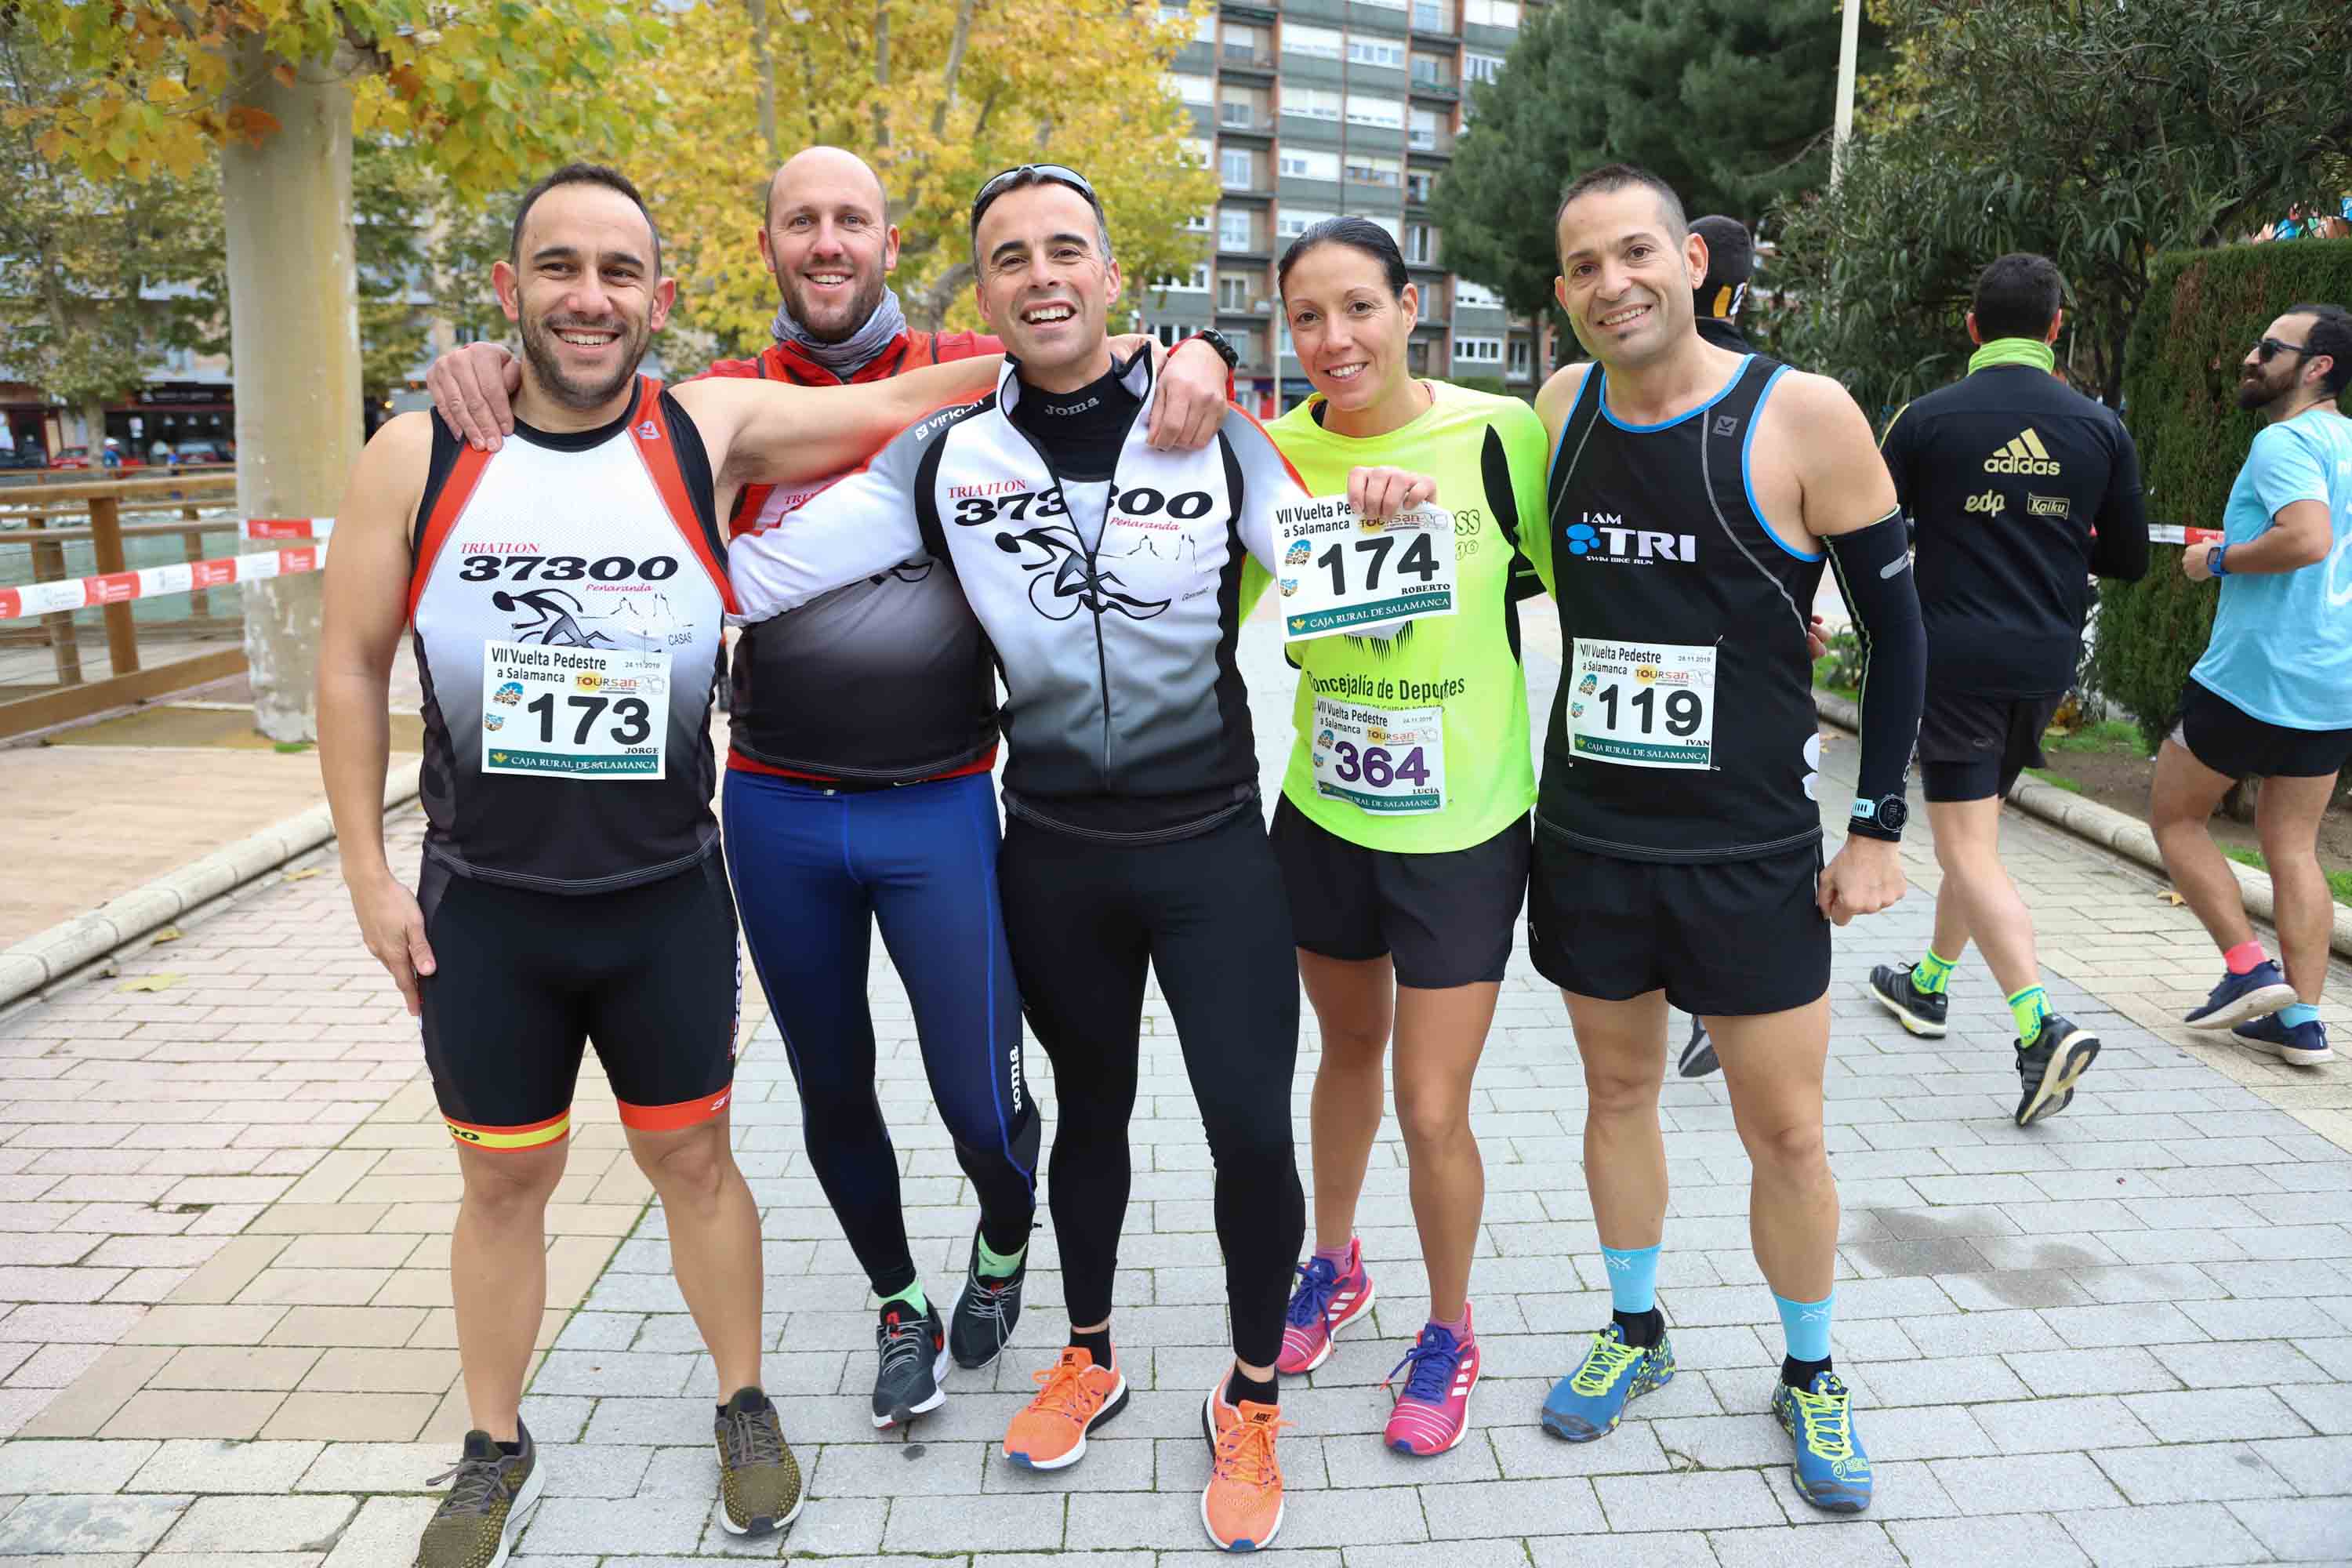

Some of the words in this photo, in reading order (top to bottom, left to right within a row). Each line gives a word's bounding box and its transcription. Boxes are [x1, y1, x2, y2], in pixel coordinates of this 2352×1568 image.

[1044, 397, 1099, 416] Joma
[1984, 456, 2060, 475] adidas
[1276, 508, 1292, 524] VII
[1294, 503, 1334, 521] Vuelta
[1964, 489, 2005, 517] edp
[1583, 512, 1588, 522] I
[1592, 513, 1621, 524] AM
[1283, 528, 1290, 538] a
[1293, 520, 1350, 536] Salamanca
[1599, 527, 1696, 562] TRI
[459, 556, 678, 581] 37300
[1318, 533, 1439, 596] 174
[1401, 583, 1450, 595] ROBERTO
[1310, 616, 1334, 628] CAJA
[1336, 610, 1369, 622] RURAL
[1370, 608, 1385, 617] DE
[1386, 597, 1450, 615] SALAMANCA
[492, 648, 508, 662] VII
[510, 649, 550, 666] Vuelta
[554, 652, 607, 670] Pedestre
[1581, 644, 1592, 657] VII
[1592, 644, 1617, 659] Vuelta
[1619, 648, 1662, 664] Pedestre
[496, 668, 503, 677] a
[506, 667, 565, 683] Salamanca
[1588, 661, 1628, 675] Salamanca
[1377, 677, 1393, 699] de
[1399, 677, 1465, 702] Deportes
[528, 693, 651, 745] 173
[1317, 700, 1327, 713] VII
[1327, 702, 1349, 720] Vuelta
[1352, 710, 1388, 728] Pedestre
[1599, 684, 1702, 737] 119
[1320, 717, 1325, 726] a
[1325, 718, 1361, 735] Salamanca
[1587, 742, 1604, 753] CAJA
[1605, 744, 1632, 756] RURAL
[1647, 750, 1708, 760] SALAMANCA
[511, 756, 537, 768] CAJA
[539, 758, 574, 769] RURAL
[575, 761, 590, 770] DE
[591, 760, 657, 771] SALAMANCA
[1334, 741, 1430, 788] 364
[1385, 800, 1439, 808] SALAMANCA
[1010, 1045, 1022, 1114] Joma
